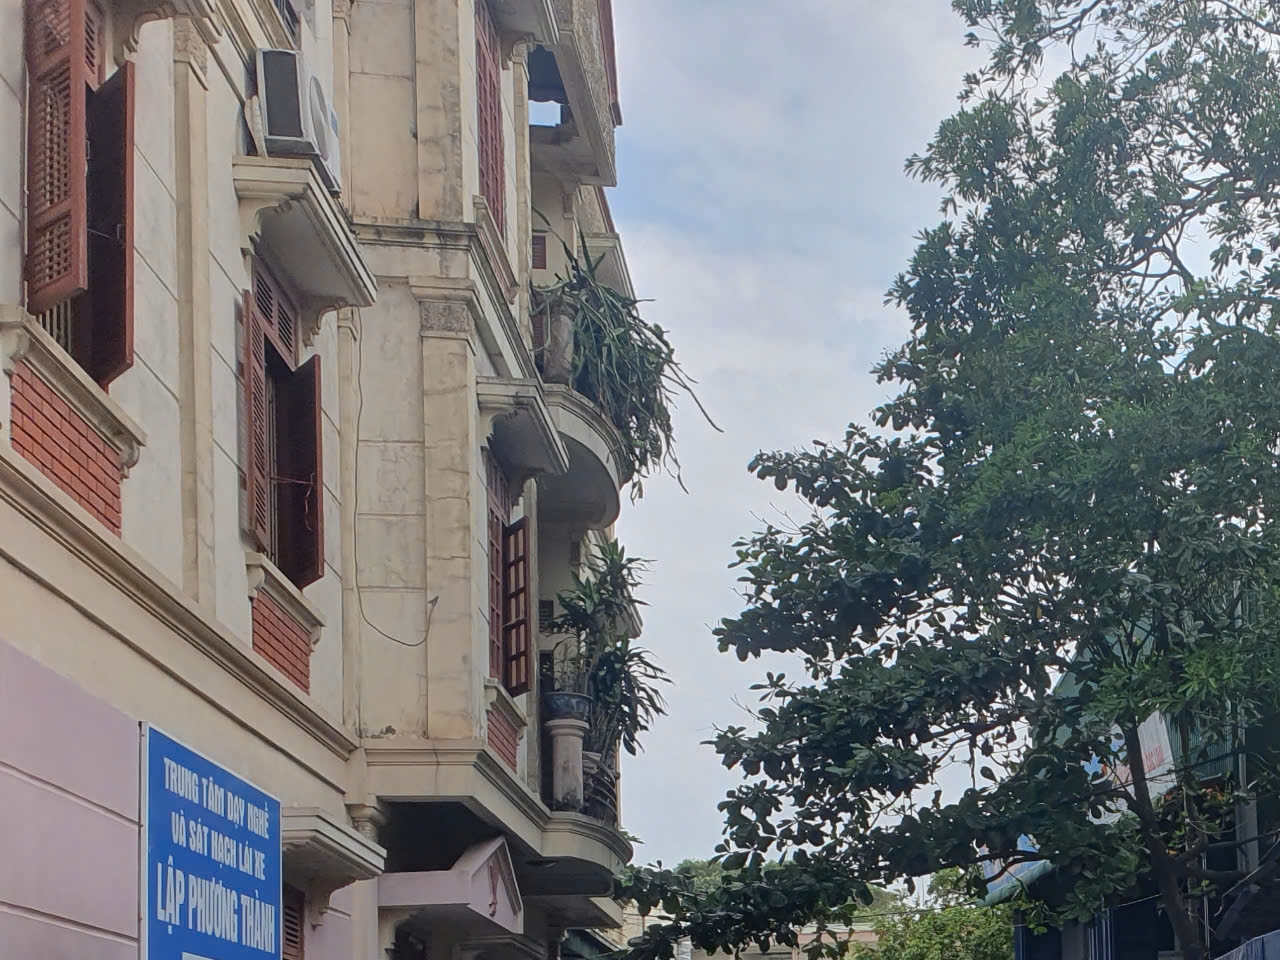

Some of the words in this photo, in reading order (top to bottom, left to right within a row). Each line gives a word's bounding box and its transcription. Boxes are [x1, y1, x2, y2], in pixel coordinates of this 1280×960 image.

[163, 756, 199, 804] TRUNG
[202, 776, 225, 818] TÂM
[226, 789, 245, 830] DẠY
[247, 803, 270, 840] NGHỀ
[171, 811, 187, 848] VÀ
[188, 817, 209, 857] SÁT
[210, 830, 237, 870] HẠCH
[238, 840, 253, 876] LÁI
[254, 849, 266, 881] XE
[156, 855, 185, 934] LẬP
[188, 873, 239, 946] PHƯƠNG
[240, 889, 276, 954] THÀNH
